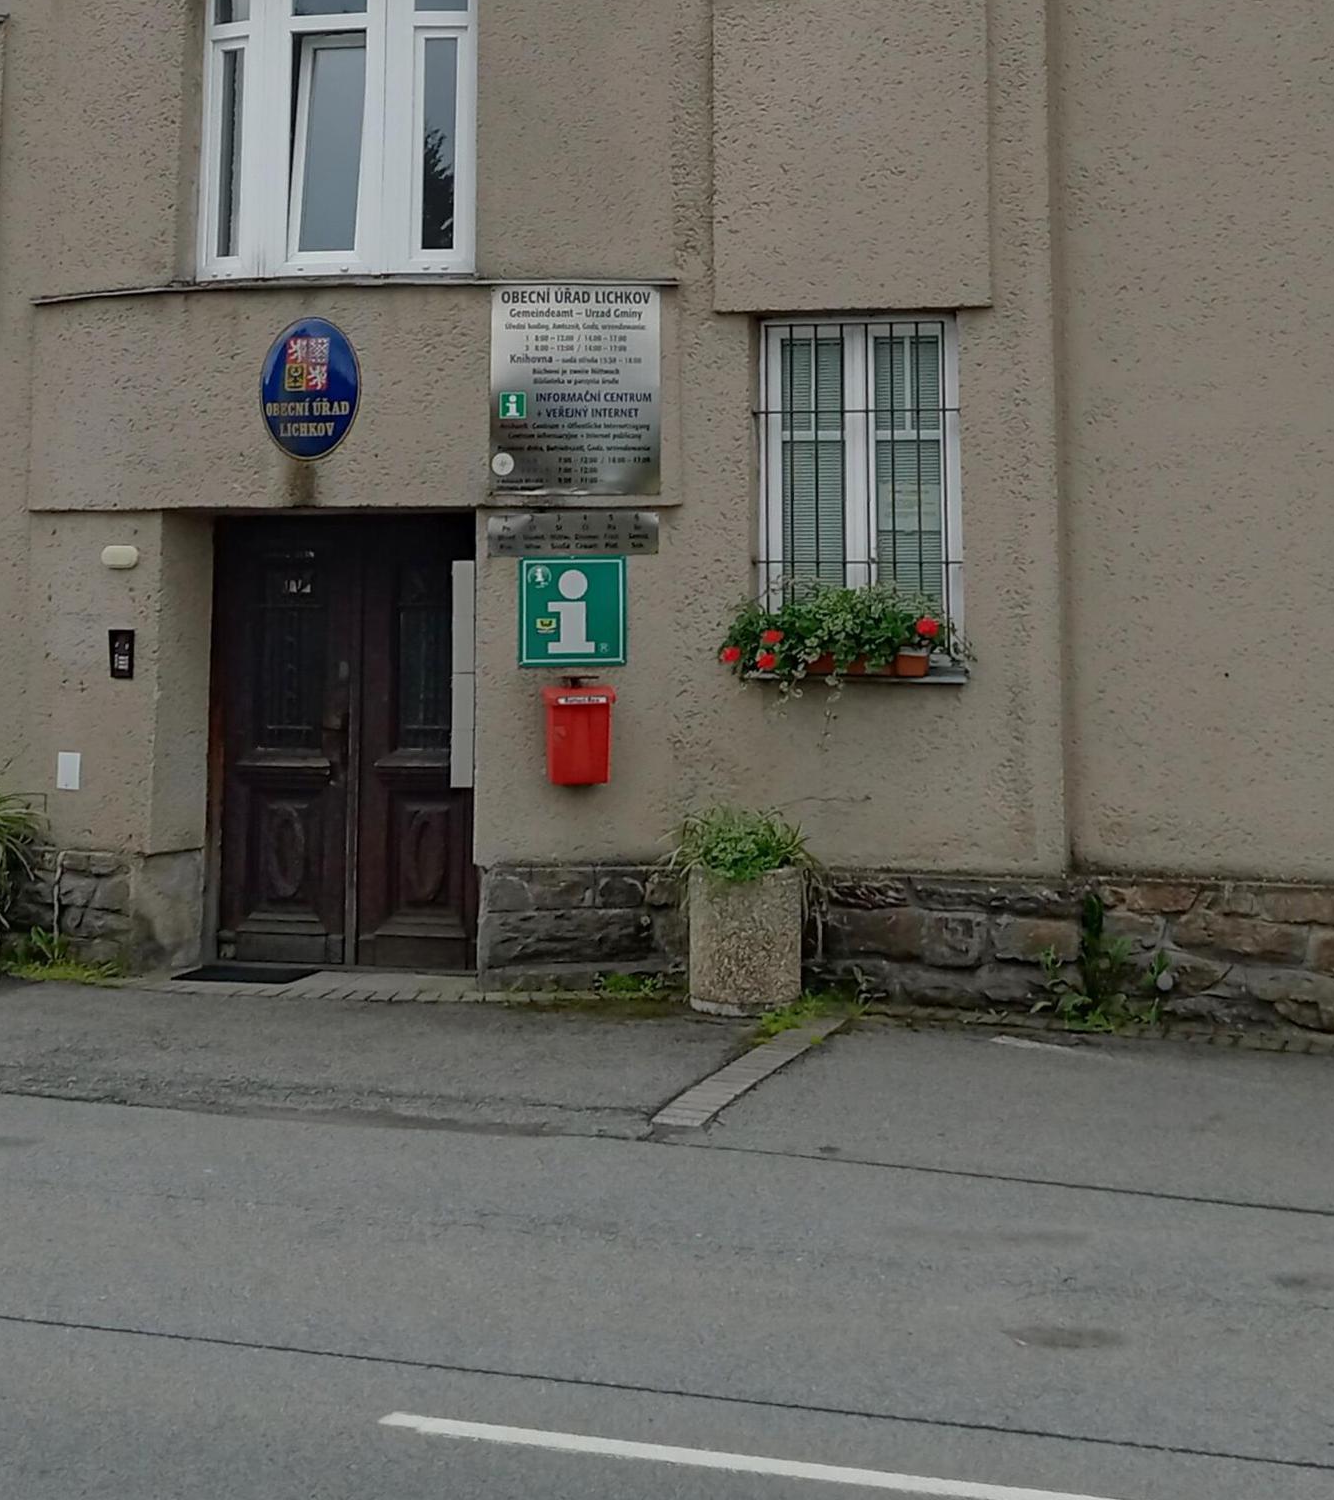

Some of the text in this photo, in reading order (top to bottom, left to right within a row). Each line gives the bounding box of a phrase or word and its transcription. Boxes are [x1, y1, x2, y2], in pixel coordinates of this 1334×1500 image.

[501, 287, 651, 304] OBECNÍ ÚŘAD LICHKOV
[509, 308, 574, 318] Gemeindeamt
[613, 308, 643, 320] Gminy
[509, 354, 553, 364] Knihovna
[535, 390, 652, 403] INFORMAČNÍ CENTRUM
[265, 397, 350, 417] OBECNÍ ÚŘAD
[545, 406, 588, 418] VEŘEJNÝ
[591, 408, 640, 418] INTERNET
[280, 422, 335, 437] LICHKOV
